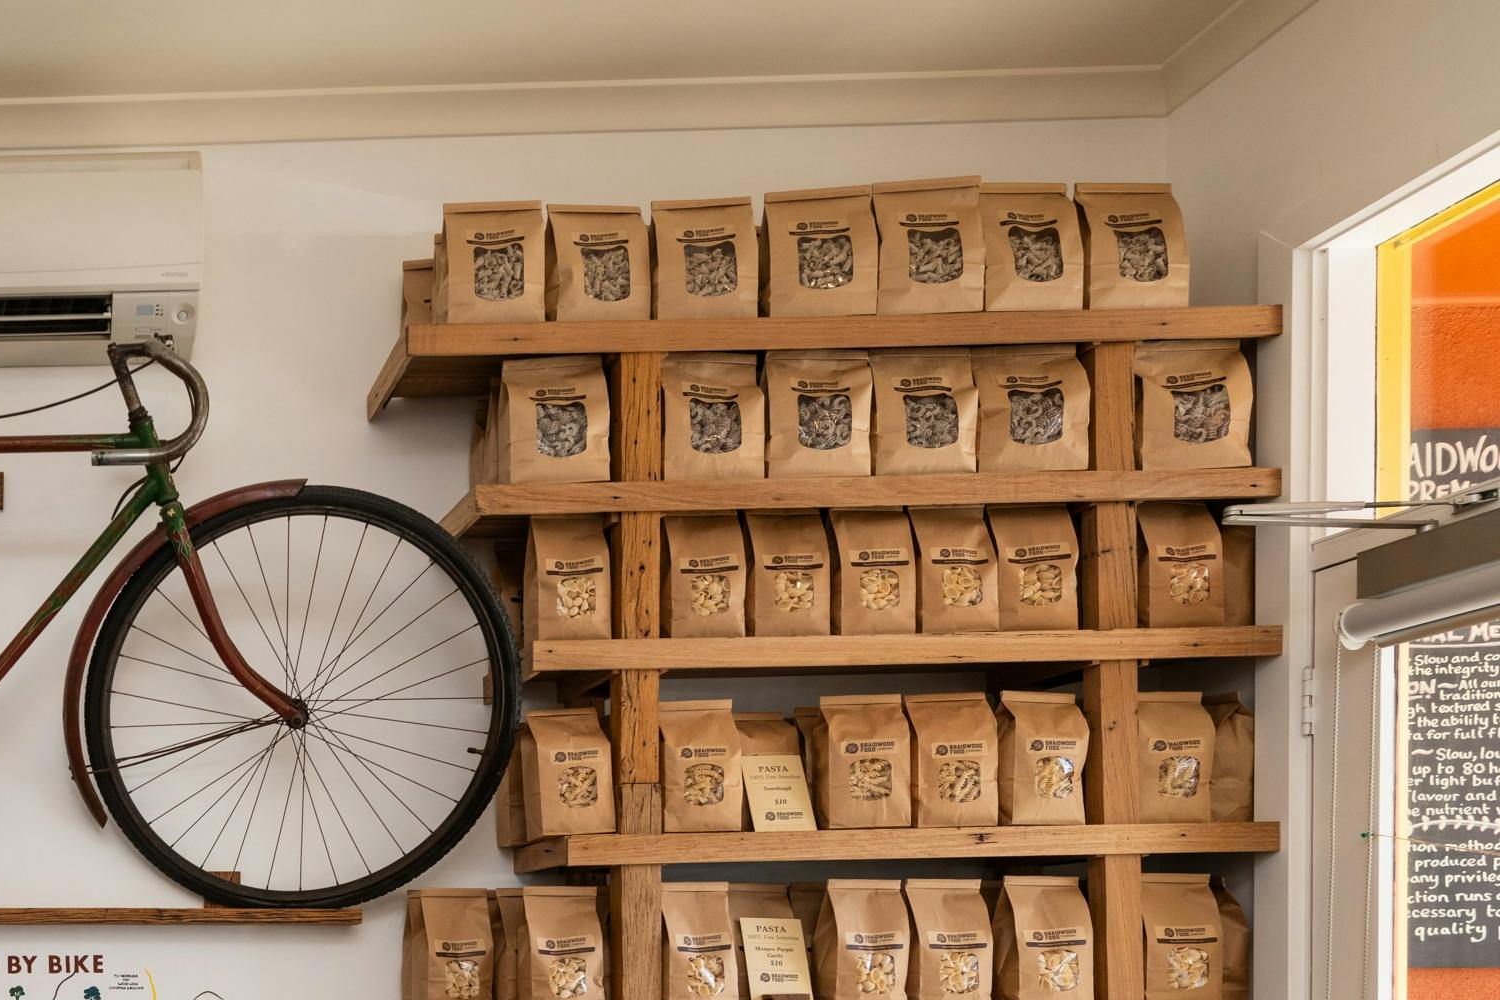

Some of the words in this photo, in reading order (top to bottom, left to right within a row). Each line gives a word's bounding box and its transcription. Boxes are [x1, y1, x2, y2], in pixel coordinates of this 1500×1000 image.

[1410, 435, 1500, 478] AIDWO
[1414, 655, 1448, 666] Slow
[1451, 651, 1480, 664] and
[1435, 661, 1500, 679] integrity
[1458, 679, 1478, 690] All
[1431, 701, 1490, 714] textured
[1417, 716, 1439, 728] the
[1441, 714, 1489, 731] ability
[1426, 730, 1451, 740] for
[1454, 728, 1484, 740] full
[1436, 748, 1477, 762] Slow,
[1412, 765, 1431, 778] up
[1437, 762, 1455, 775] to
[1462, 762, 1485, 775] 80
[1429, 774, 1467, 790] light
[1465, 789, 1497, 801] and
[1426, 803, 1491, 816] nutrient
[1415, 855, 1487, 872] produced
[1455, 892, 1492, 902] runs
[1414, 922, 1487, 943] quality
[7, 955, 38, 974] BY
[49, 954, 104, 974] BIKE
